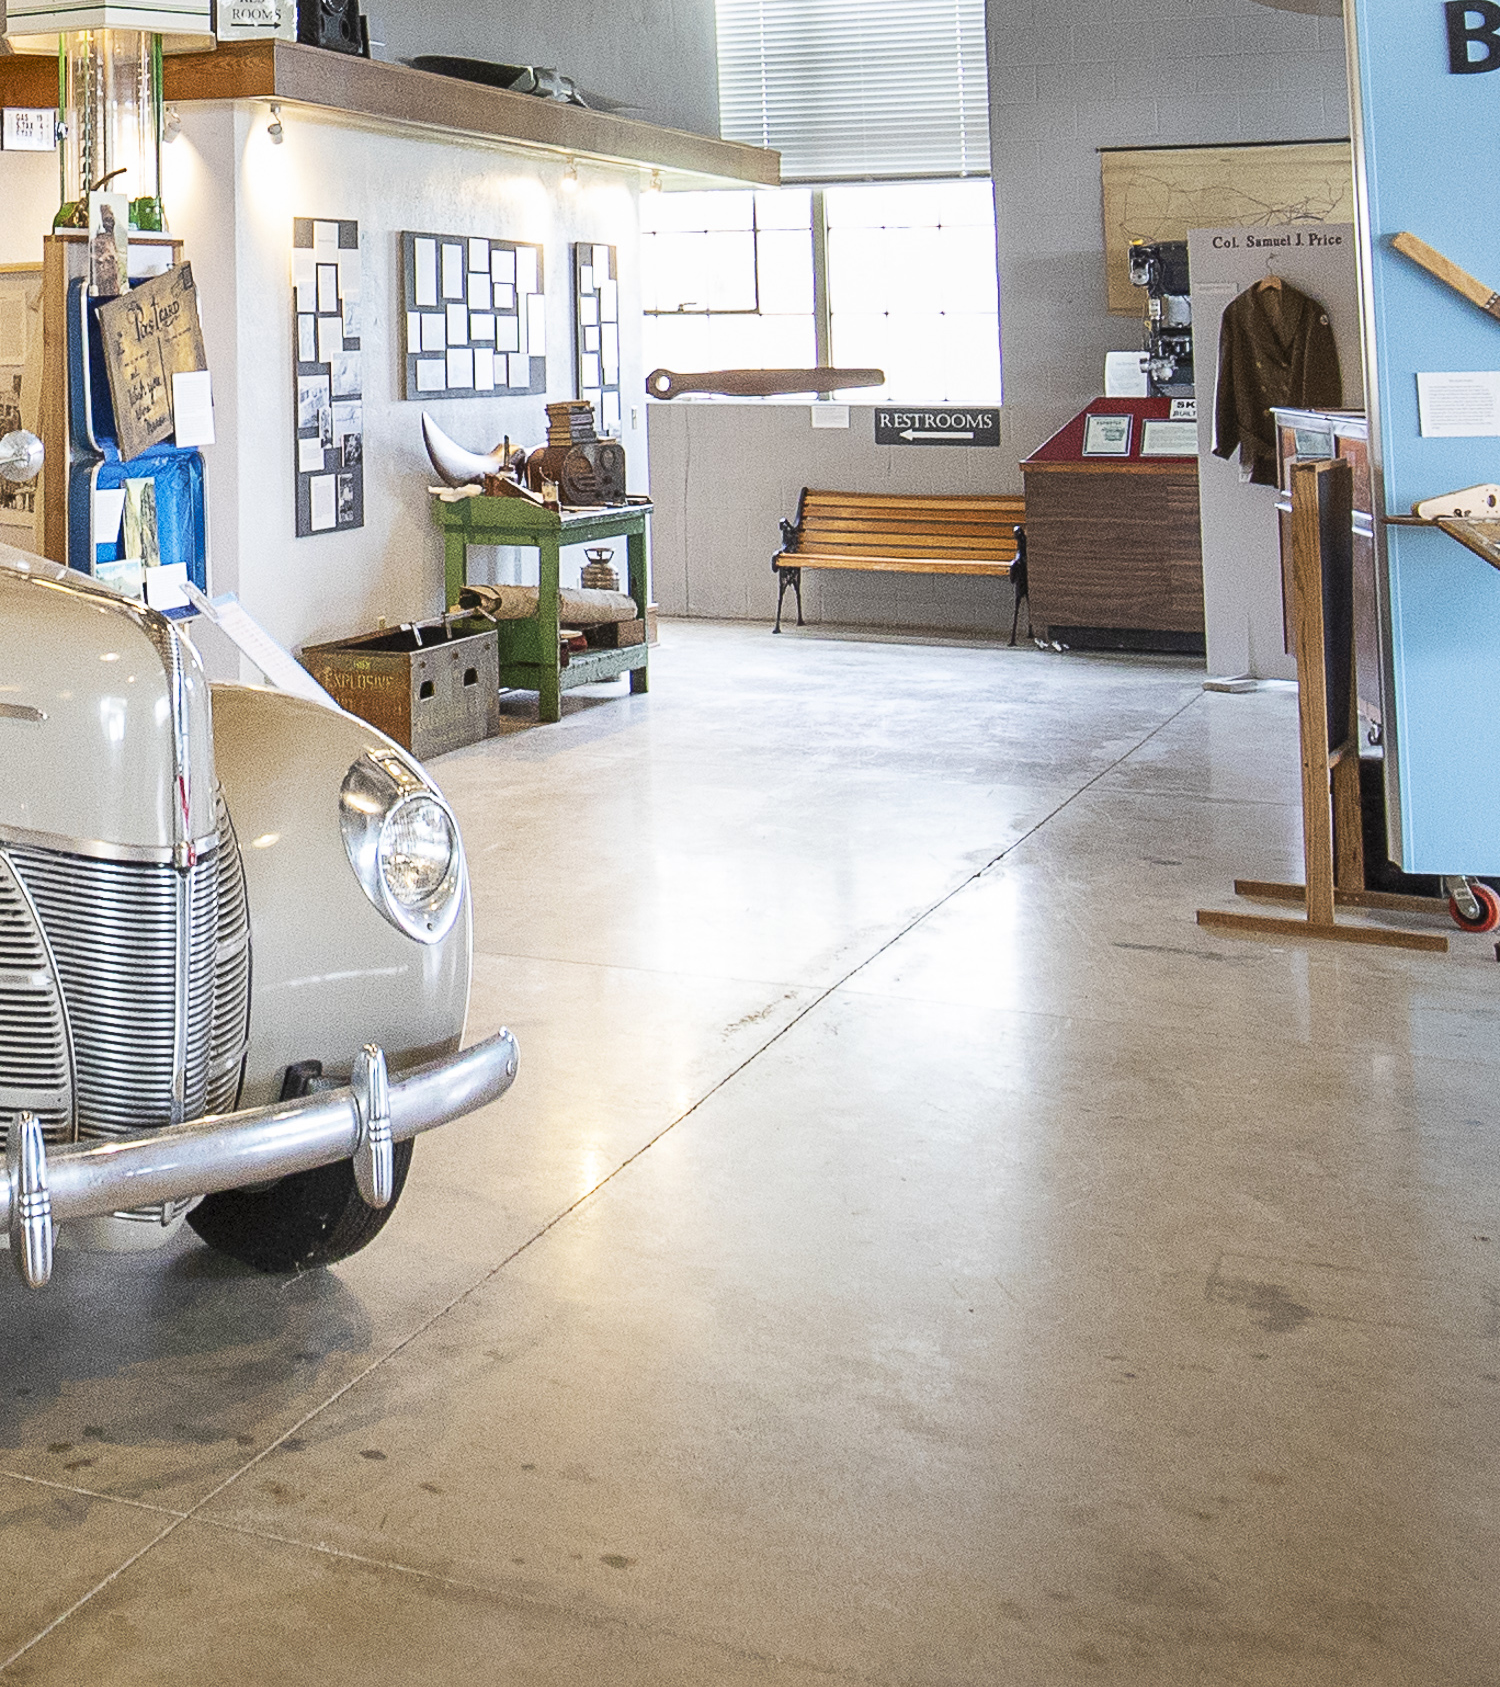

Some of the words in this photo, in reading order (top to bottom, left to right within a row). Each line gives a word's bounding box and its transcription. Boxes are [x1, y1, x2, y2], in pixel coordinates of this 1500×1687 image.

[1212, 236, 1239, 249] Col.
[1246, 234, 1291, 248] Samuel
[1308, 232, 1343, 247] Price
[879, 413, 993, 429] RESTROOMS
